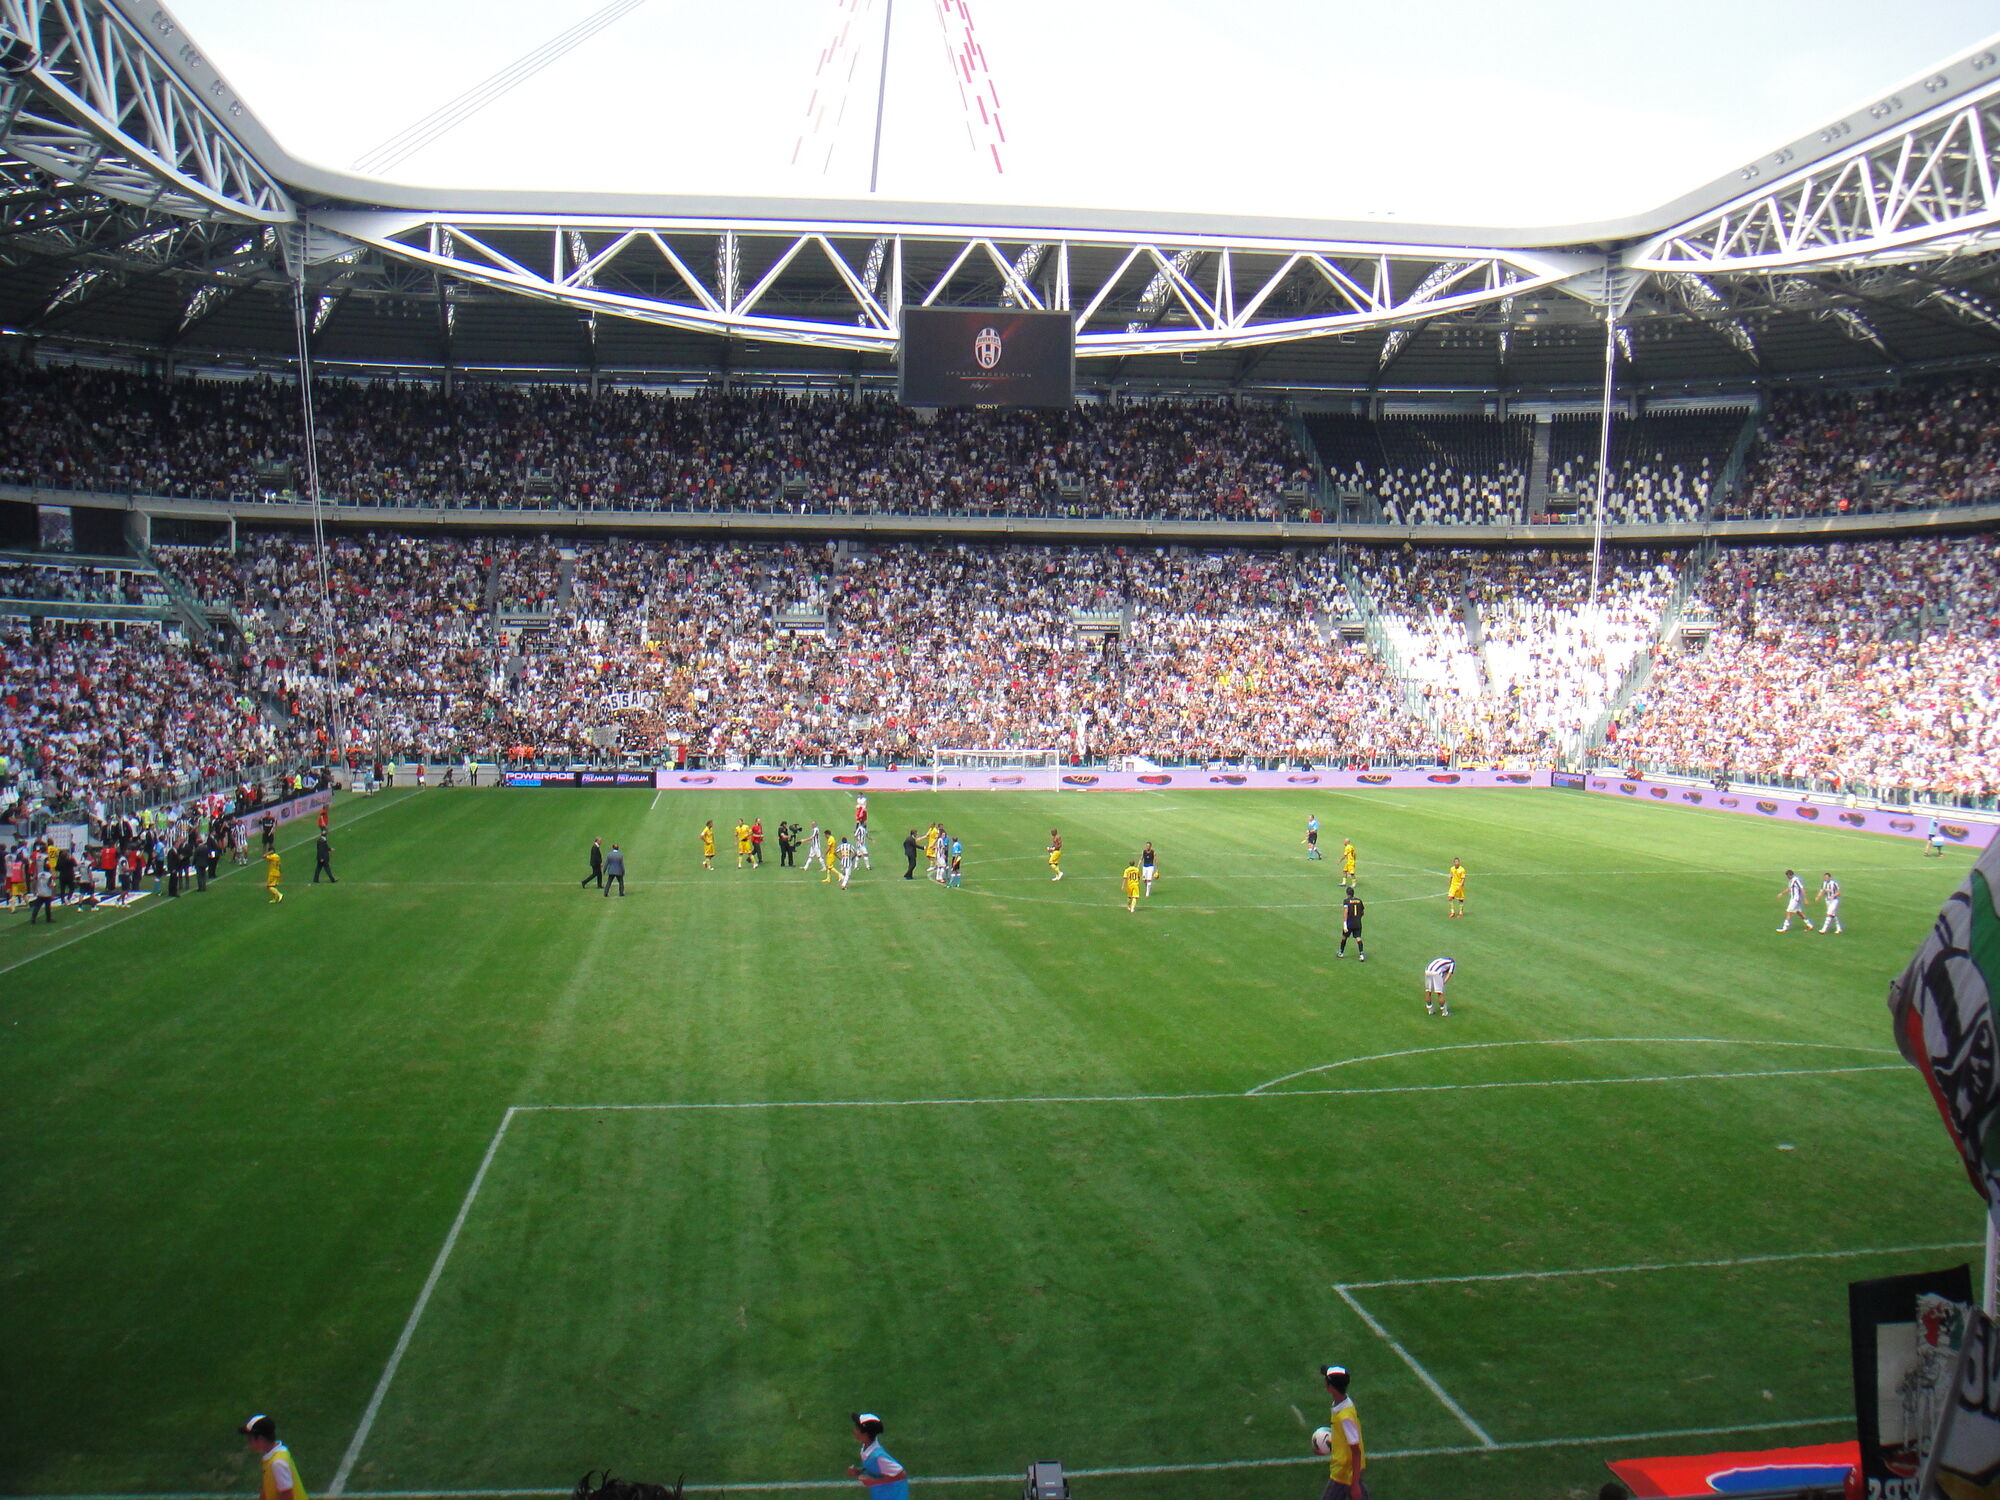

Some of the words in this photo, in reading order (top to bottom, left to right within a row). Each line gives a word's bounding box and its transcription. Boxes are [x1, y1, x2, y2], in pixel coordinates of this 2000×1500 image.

[505, 772, 575, 780] POWERADE
[581, 774, 614, 782] PREMIUM
[617, 774, 649, 782] PREMIUM
[1129, 871, 1138, 881] 10
